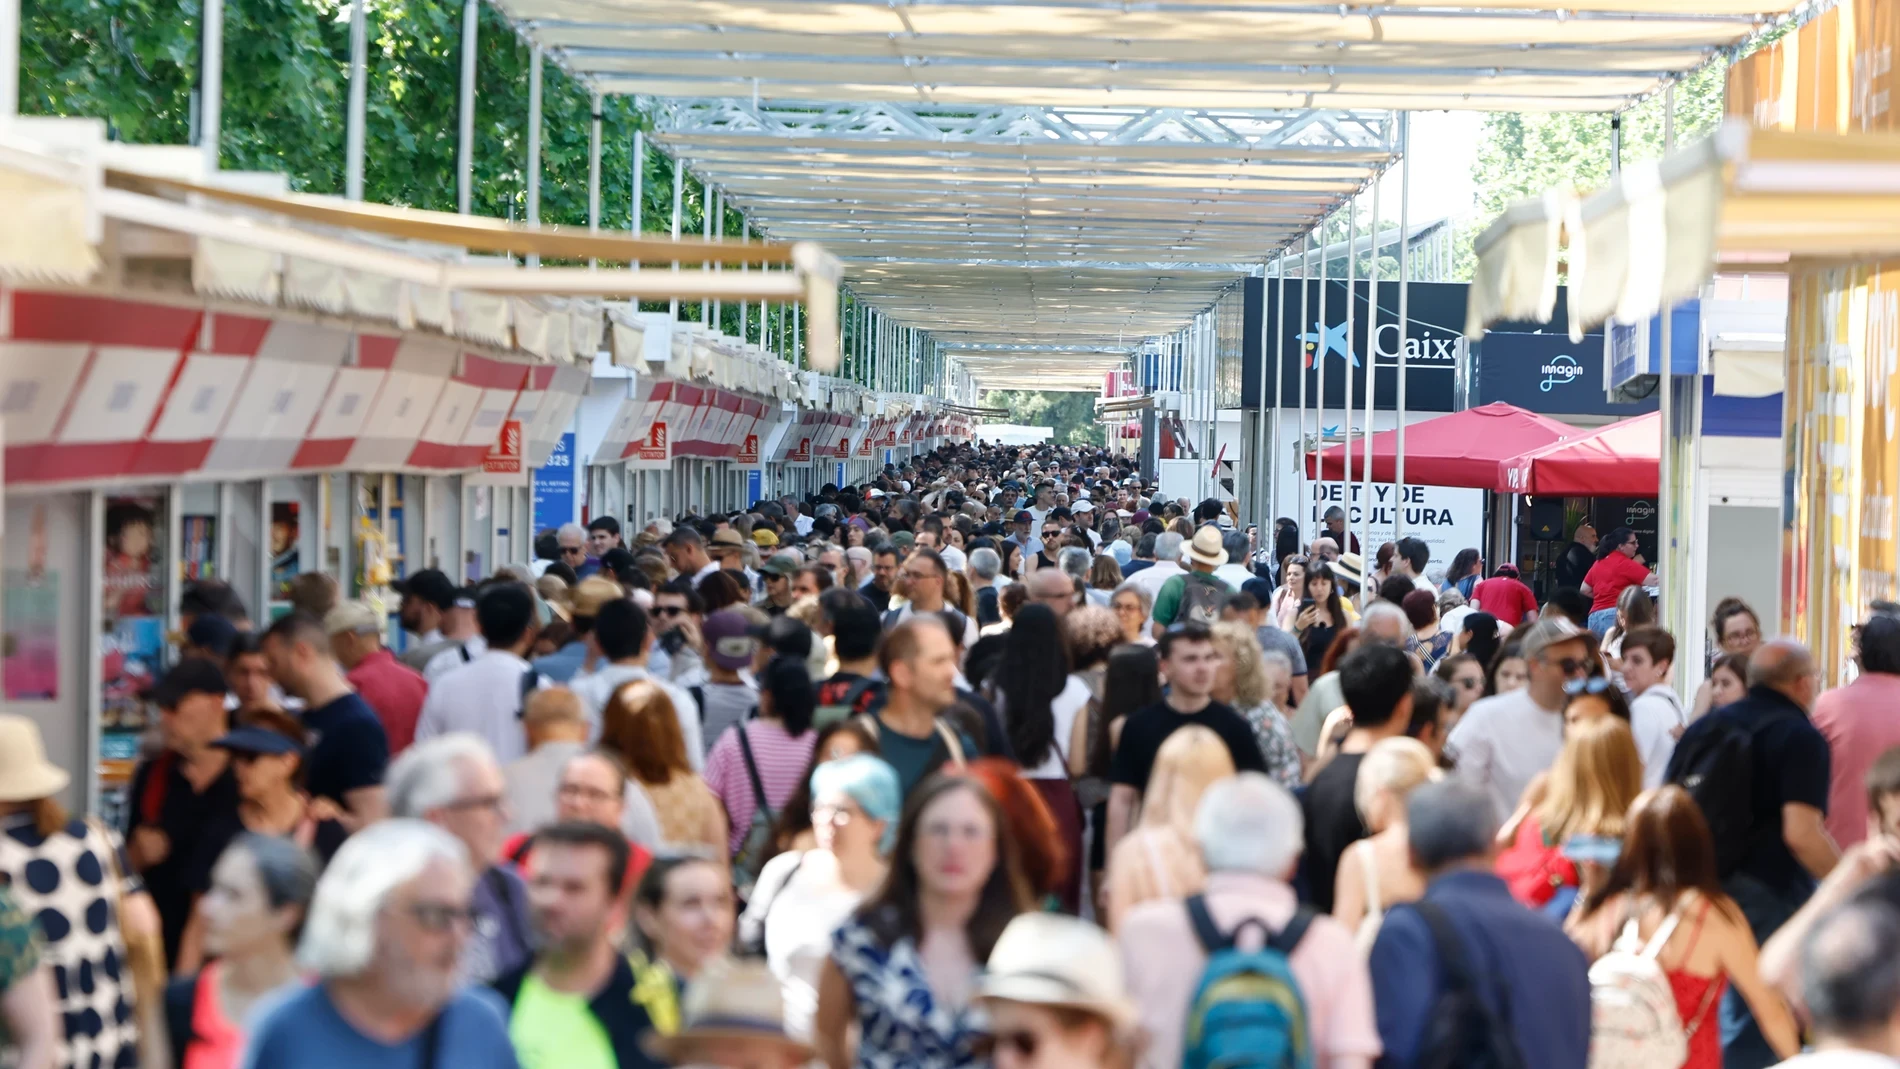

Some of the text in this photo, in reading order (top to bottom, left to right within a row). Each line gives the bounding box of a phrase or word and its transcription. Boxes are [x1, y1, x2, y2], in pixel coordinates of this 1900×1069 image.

[1541, 364, 1583, 377] imagin
[1375, 486, 1389, 502] Y
[1626, 507, 1655, 516] imagin
